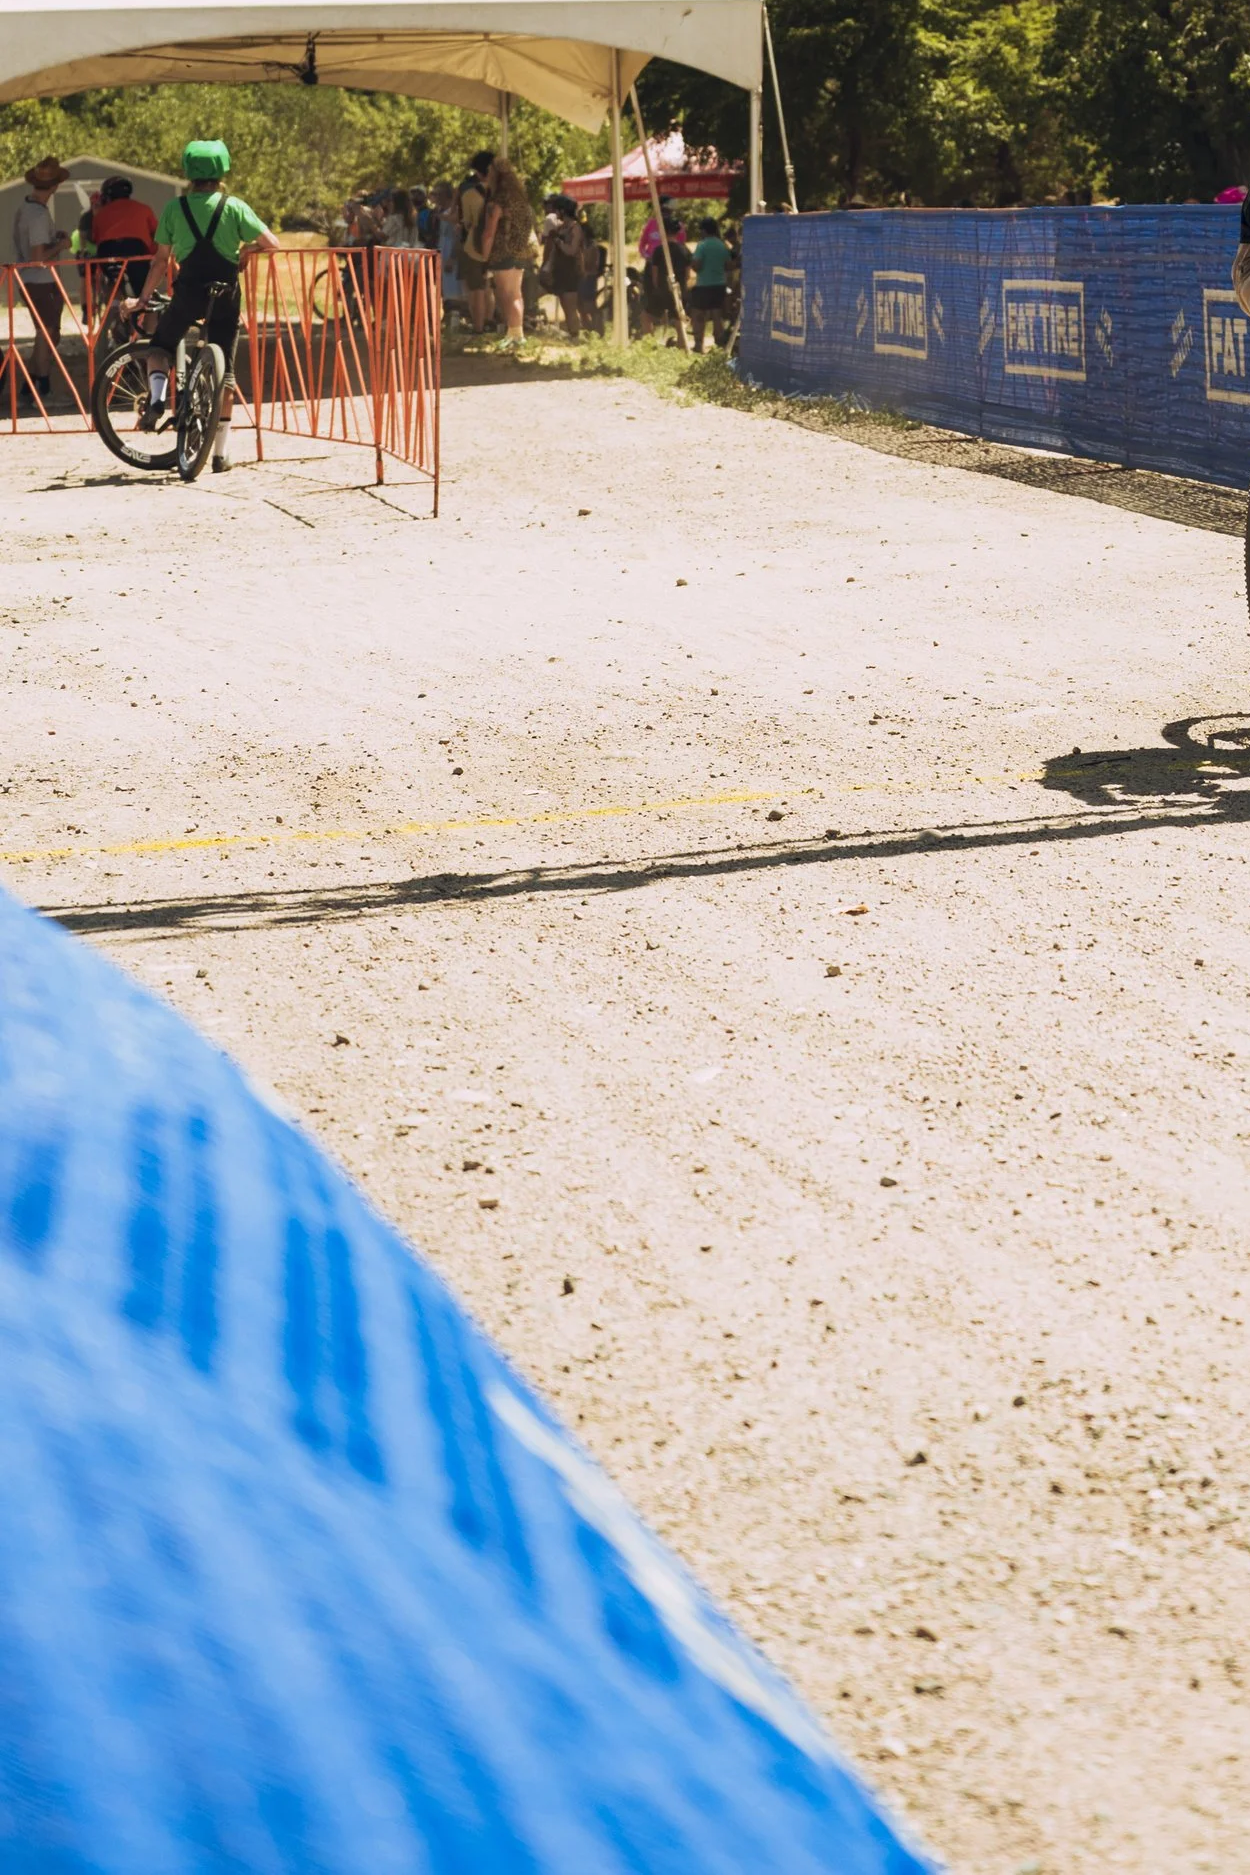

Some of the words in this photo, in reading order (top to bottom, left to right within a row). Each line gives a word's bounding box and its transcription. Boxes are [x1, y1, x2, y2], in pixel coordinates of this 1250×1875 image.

[876, 290, 895, 334] FAT
[897, 291, 925, 338] TIRE
[1007, 302, 1036, 352] FAT
[1038, 303, 1080, 357] TIRE
[1210, 316, 1247, 377] FAT
